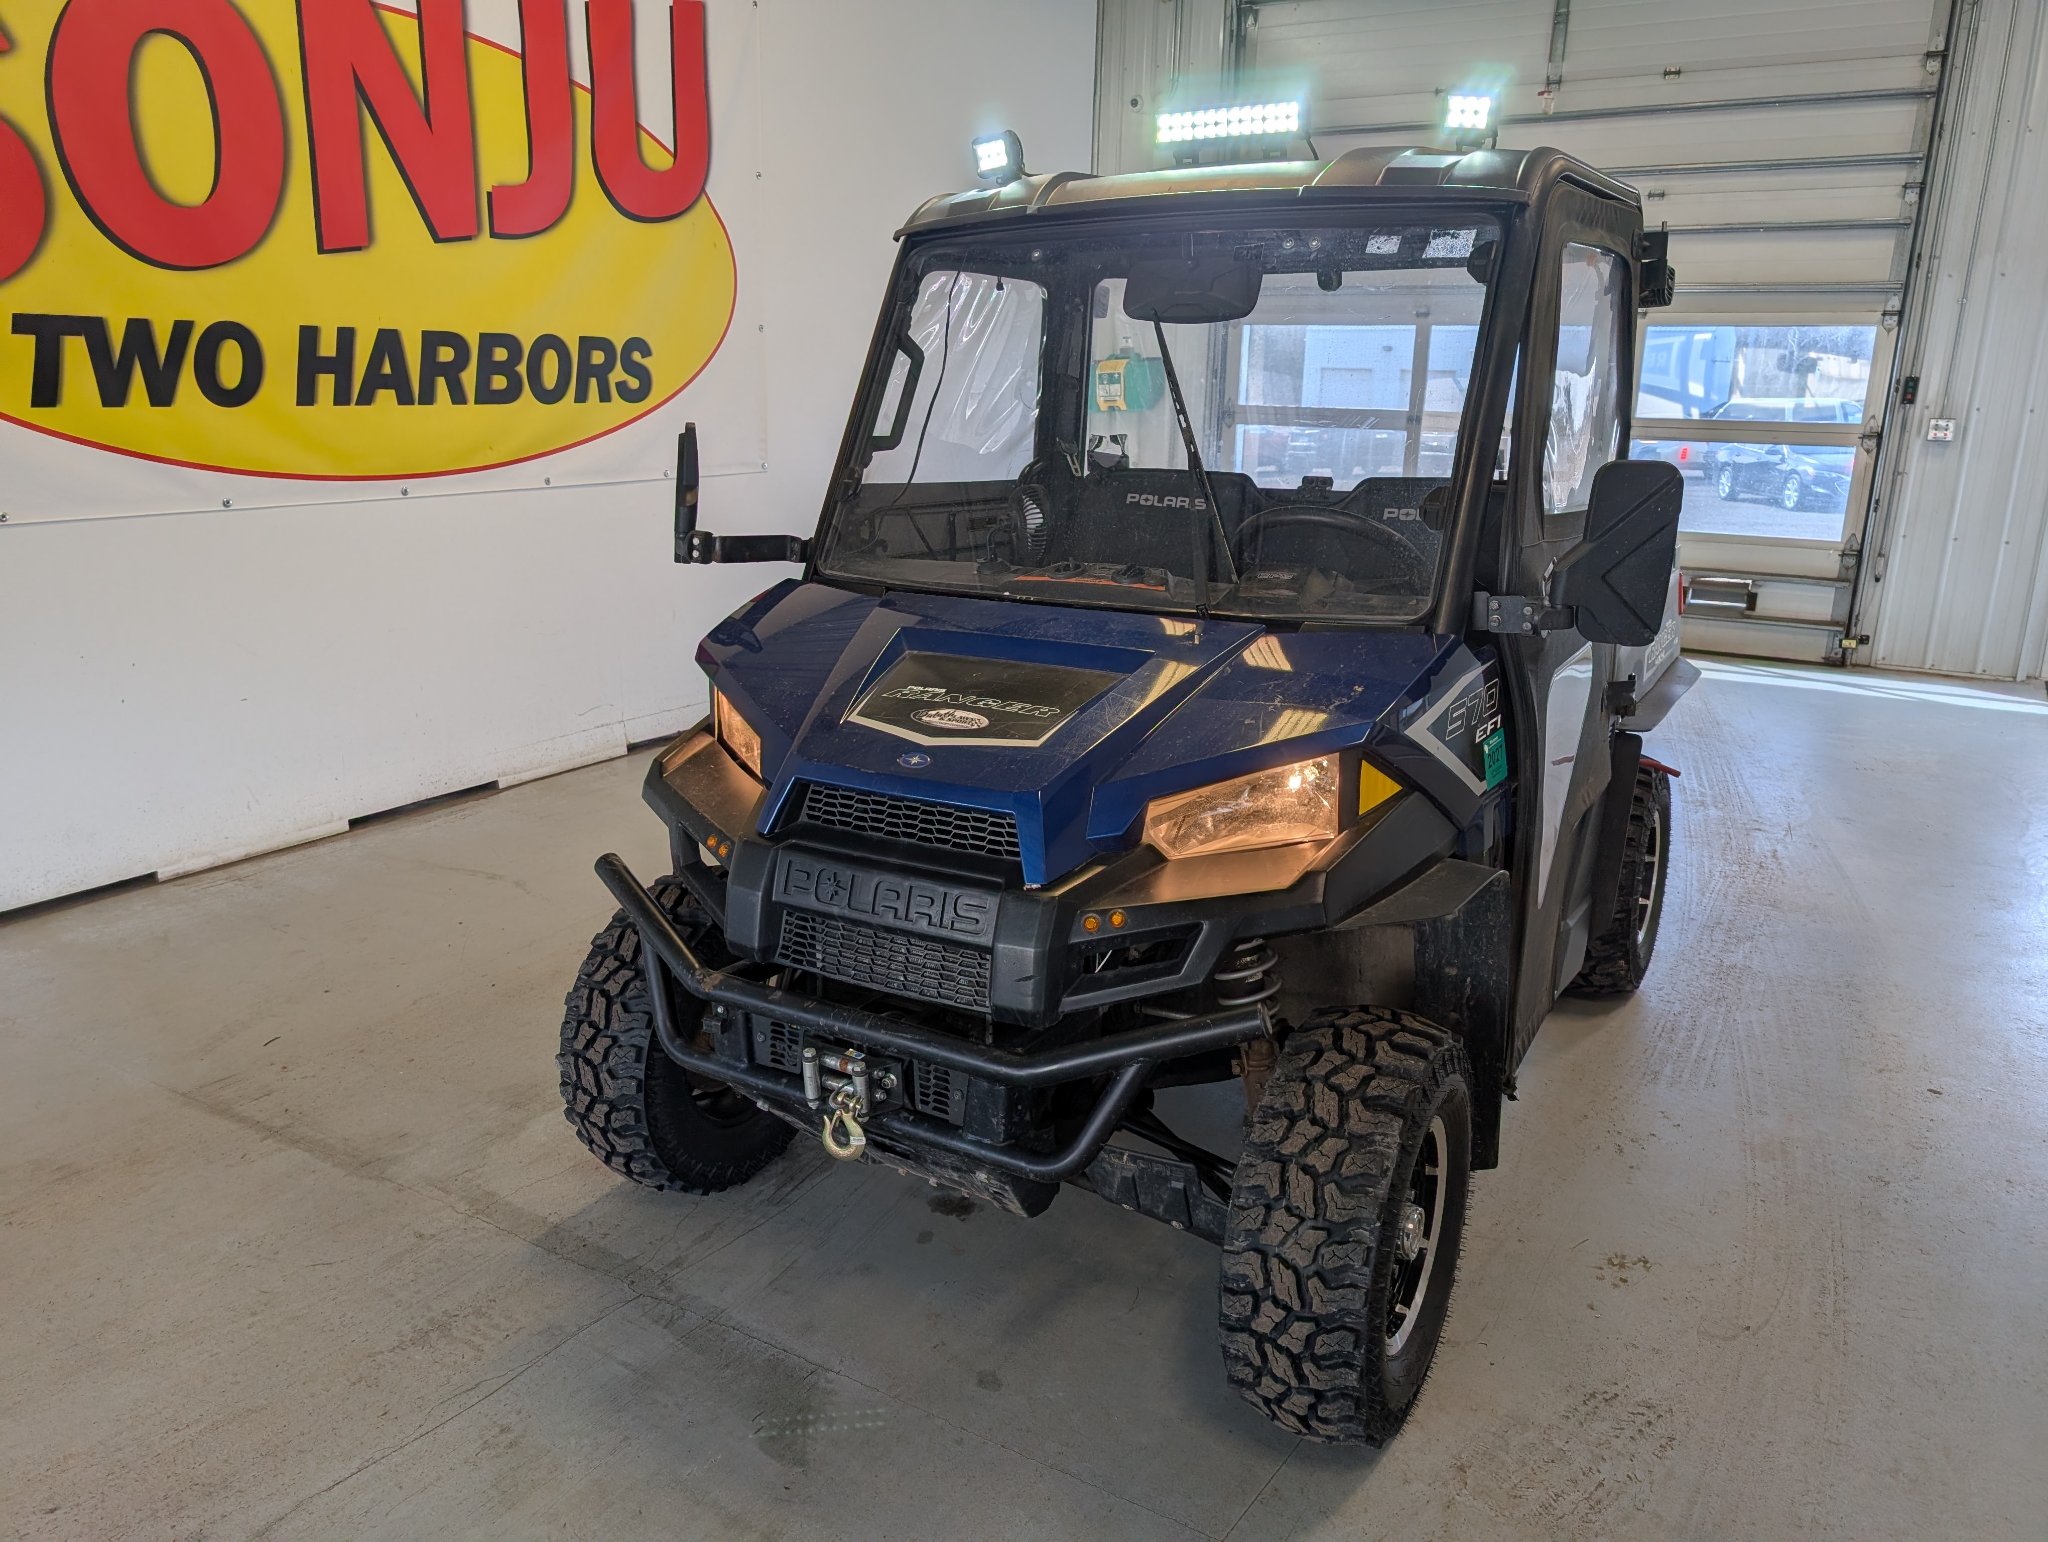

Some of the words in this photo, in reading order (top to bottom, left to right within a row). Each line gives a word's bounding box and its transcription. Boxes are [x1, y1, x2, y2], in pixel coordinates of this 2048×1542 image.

[12, 313, 264, 408] TWO
[295, 325, 653, 406] HARBORS
[881, 688, 1061, 717] RANGER
[1446, 678, 1500, 740] 570
[1475, 714, 1502, 743] EFI
[1487, 744, 1503, 769] 2027
[784, 859, 991, 937] POLARIS
